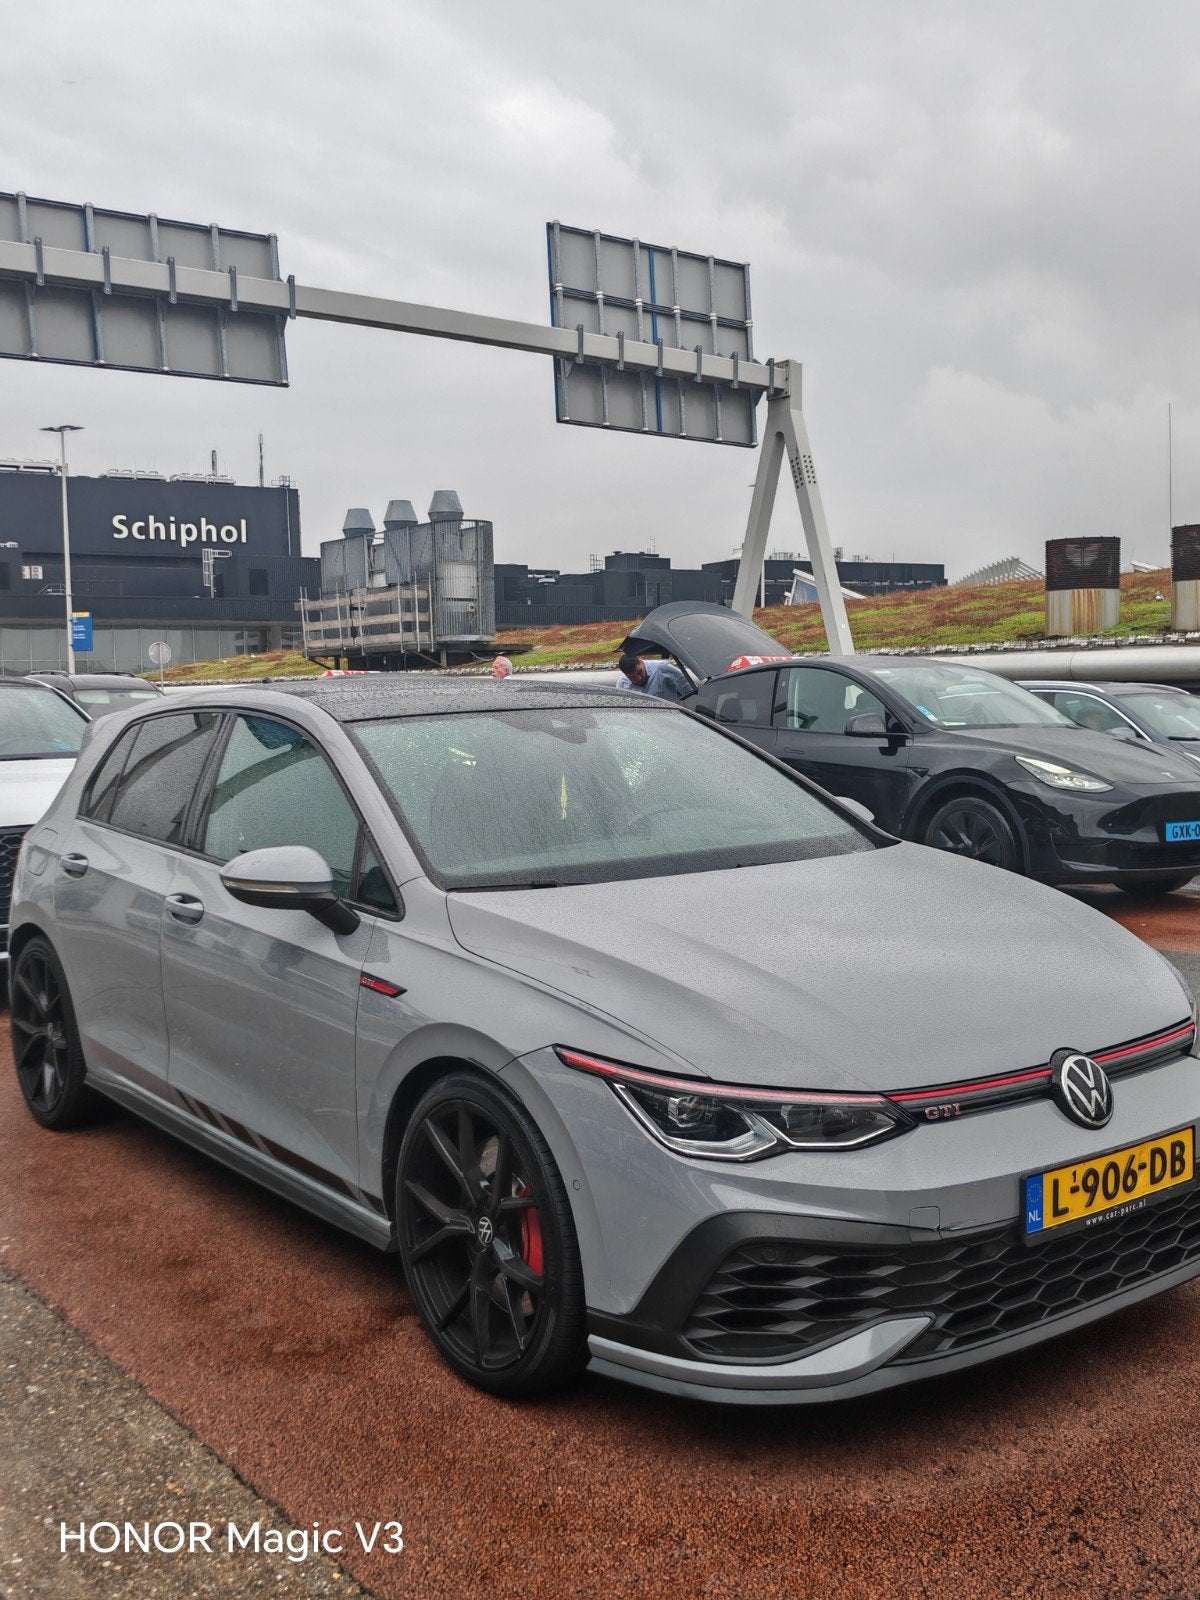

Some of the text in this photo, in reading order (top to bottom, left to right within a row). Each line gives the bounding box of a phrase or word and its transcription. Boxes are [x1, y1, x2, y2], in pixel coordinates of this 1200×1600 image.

[112, 514, 247, 548] Schiphol
[924, 1102, 961, 1120] GTI
[1052, 1139, 1186, 1218] L-906-DB
[1028, 1209, 1041, 1224] NL
[1085, 1199, 1146, 1226] www.car-parc.nl
